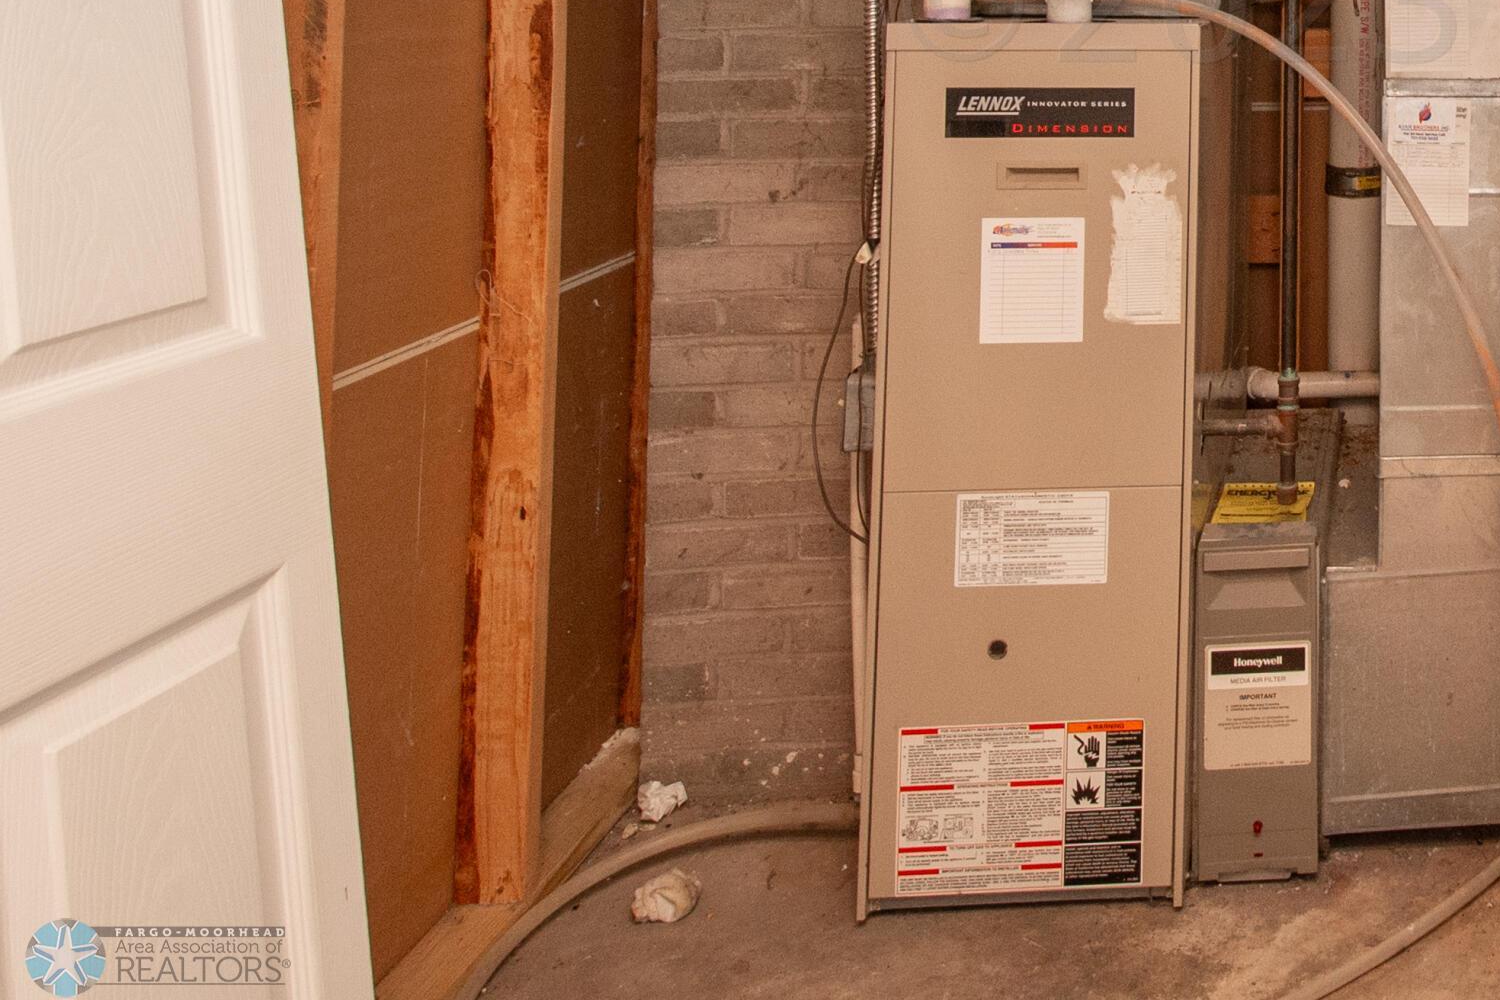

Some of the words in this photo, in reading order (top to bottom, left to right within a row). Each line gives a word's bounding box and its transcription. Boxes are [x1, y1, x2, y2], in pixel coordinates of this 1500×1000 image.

[957, 96, 1025, 111] LENNOX
[1233, 656, 1283, 669] Honeywell
[1230, 677, 1250, 685] MEDIA
[1251, 676, 1262, 684] AIR
[1263, 675, 1287, 683] FILTER
[1239, 693, 1277, 701] IMPORTANT
